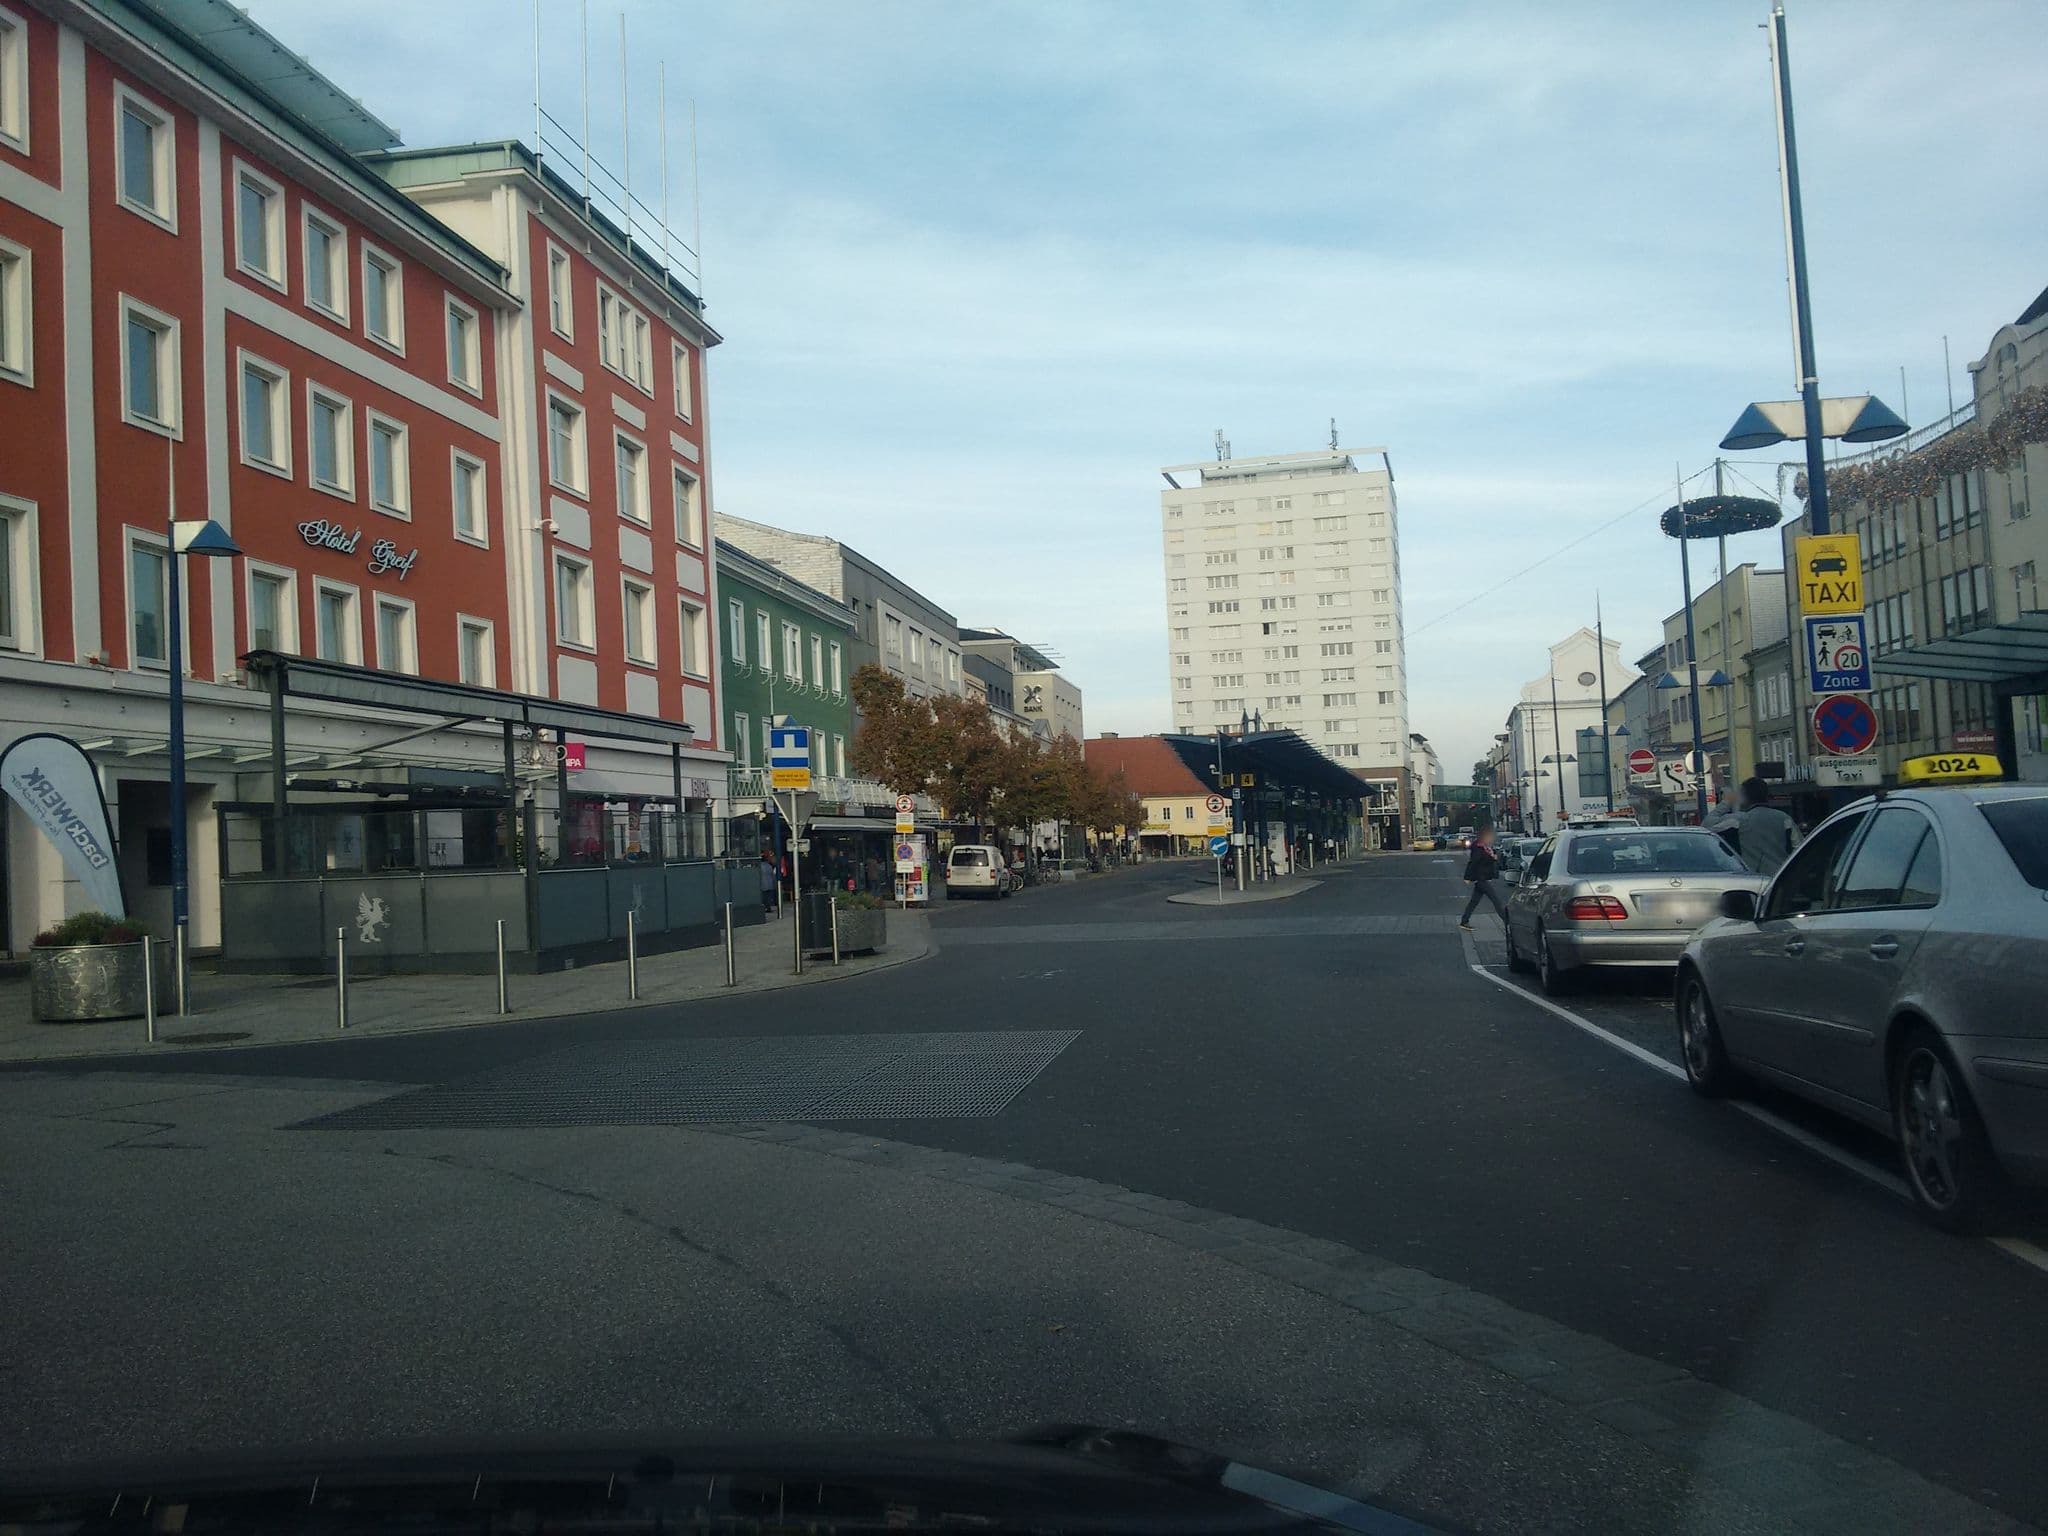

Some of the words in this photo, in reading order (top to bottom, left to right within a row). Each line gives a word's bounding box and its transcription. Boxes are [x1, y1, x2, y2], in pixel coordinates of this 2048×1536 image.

[298, 519, 361, 554] Hotel
[367, 539, 418, 581] Greif
[1805, 581, 1857, 604] TAXI
[1840, 652, 1860, 668] 20
[1822, 674, 1861, 688] Zone
[1023, 705, 1043, 713] BANK
[1819, 757, 1877, 769] ausgenommen
[1928, 757, 1980, 774] 2024
[1836, 769, 1862, 782] Taxi
